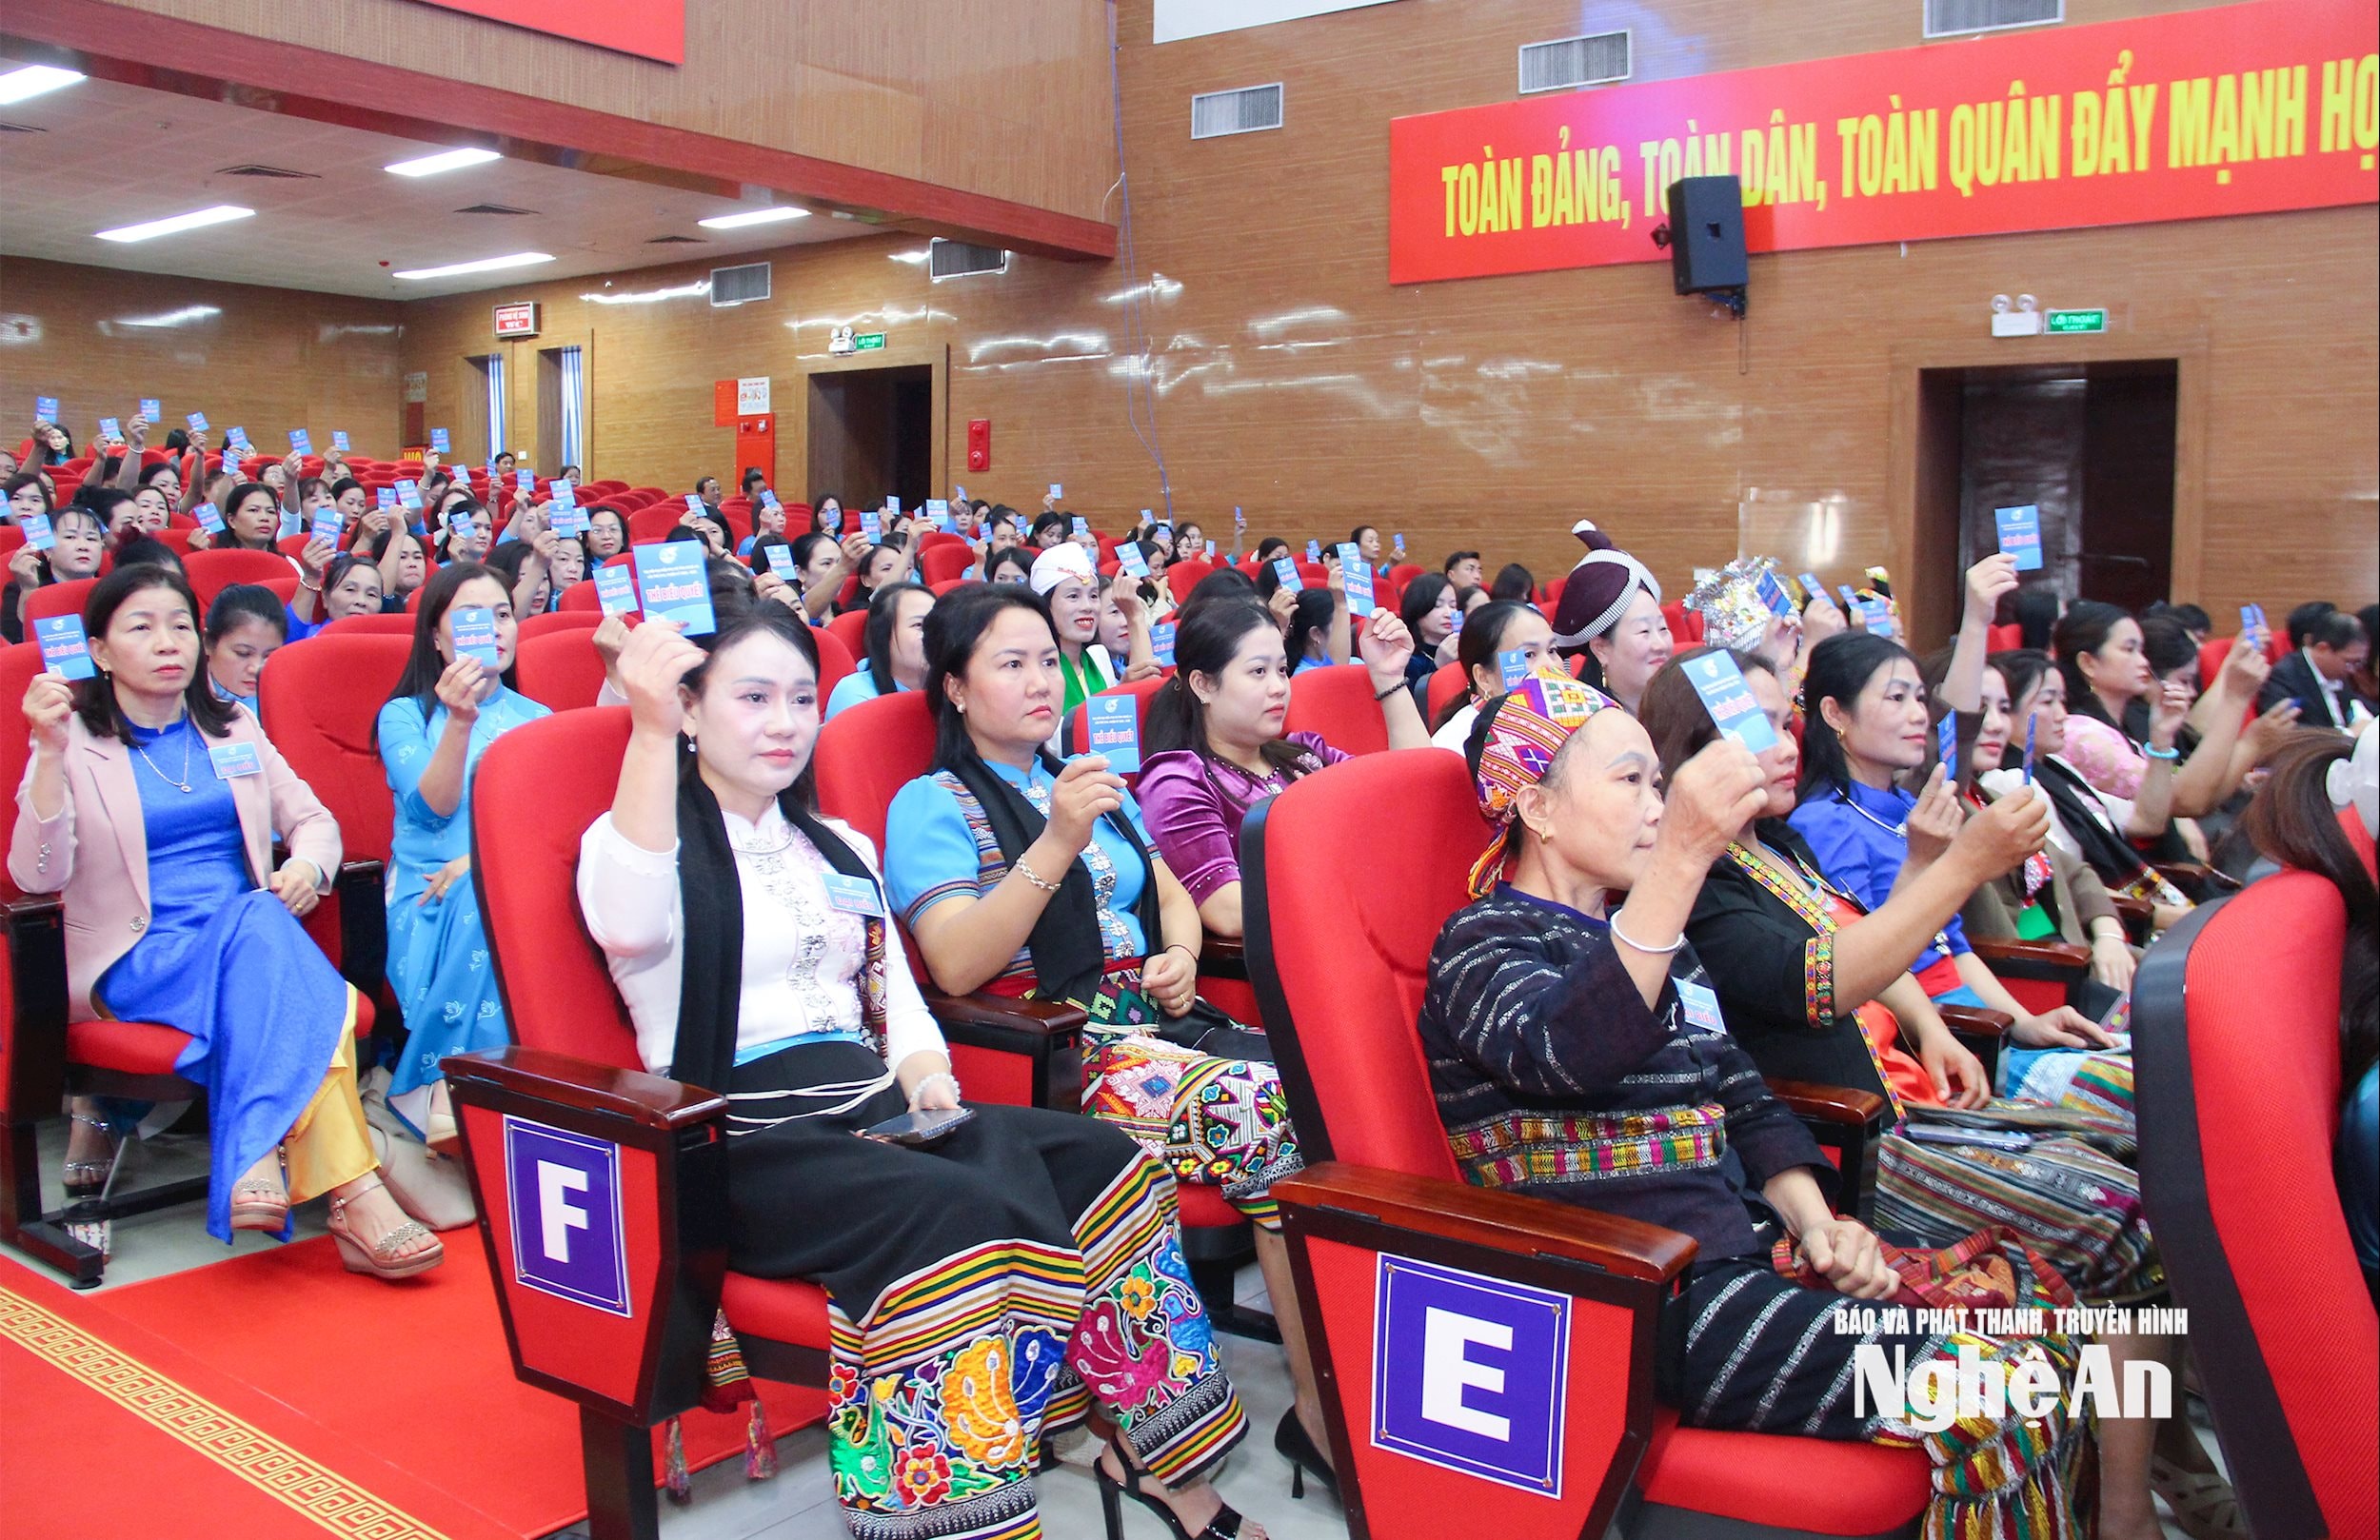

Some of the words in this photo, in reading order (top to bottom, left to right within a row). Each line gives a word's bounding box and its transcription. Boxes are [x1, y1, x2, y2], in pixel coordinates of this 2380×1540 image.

[1441, 146, 1521, 237] TOÀN
[1531, 126, 1631, 229] ĐẢNG,
[1740, 109, 1827, 211] DÂN,
[1837, 95, 1938, 198] TOÀN
[1950, 80, 2061, 198] QUÂN
[2072, 49, 2158, 177] ĐẨY
[2169, 65, 2308, 185] MẠNH
[505, 320, 524, 329] WC
[537, 1159, 589, 1263] F
[1421, 1306, 1513, 1443] E
